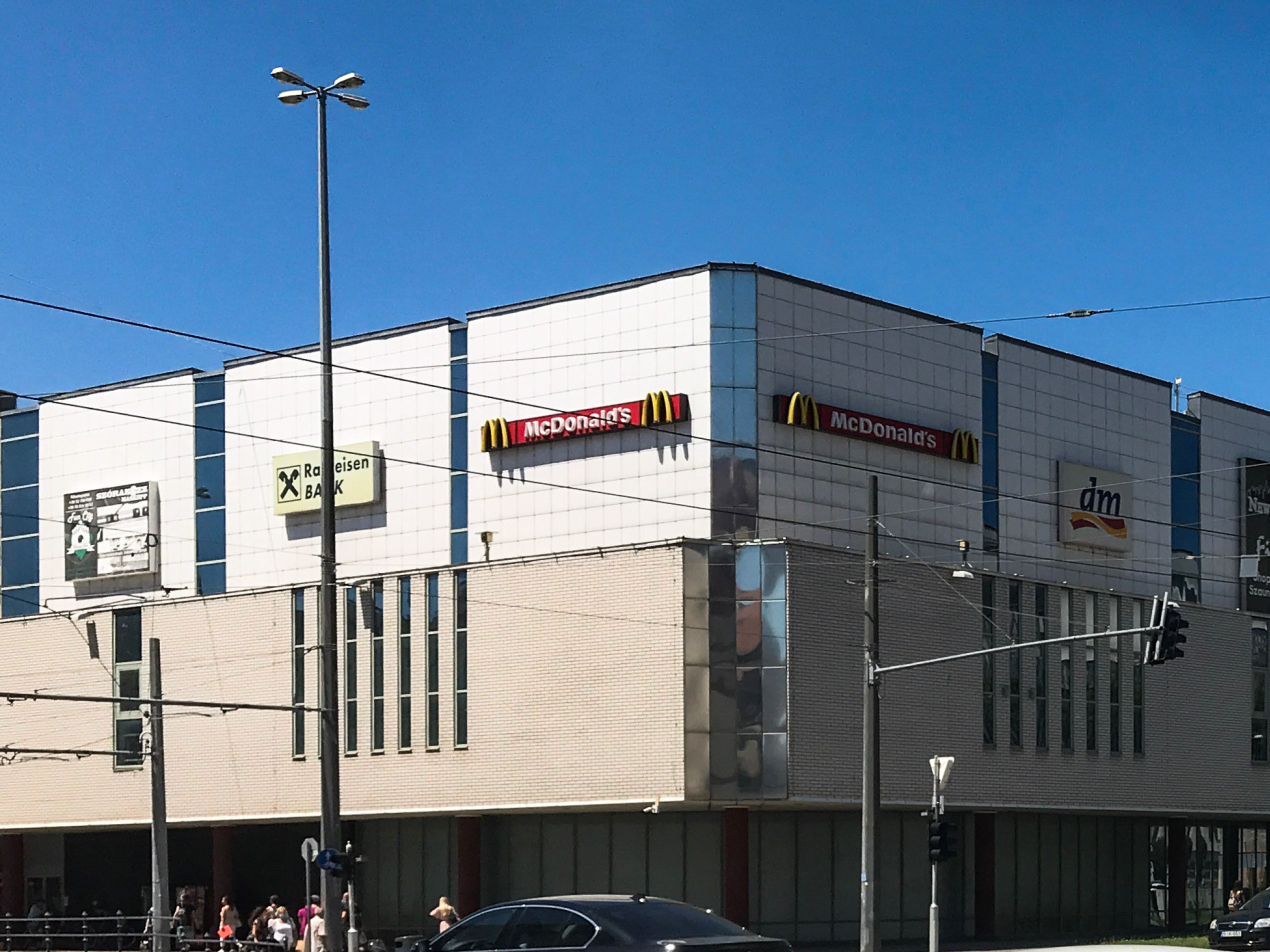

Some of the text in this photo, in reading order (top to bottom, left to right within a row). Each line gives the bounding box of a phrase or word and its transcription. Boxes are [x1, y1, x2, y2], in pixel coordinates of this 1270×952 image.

[524, 407, 631, 438] McDonald's
[831, 411, 937, 449] McDonald's
[304, 479, 344, 500] BAK
[1080, 476, 1121, 516] dm
